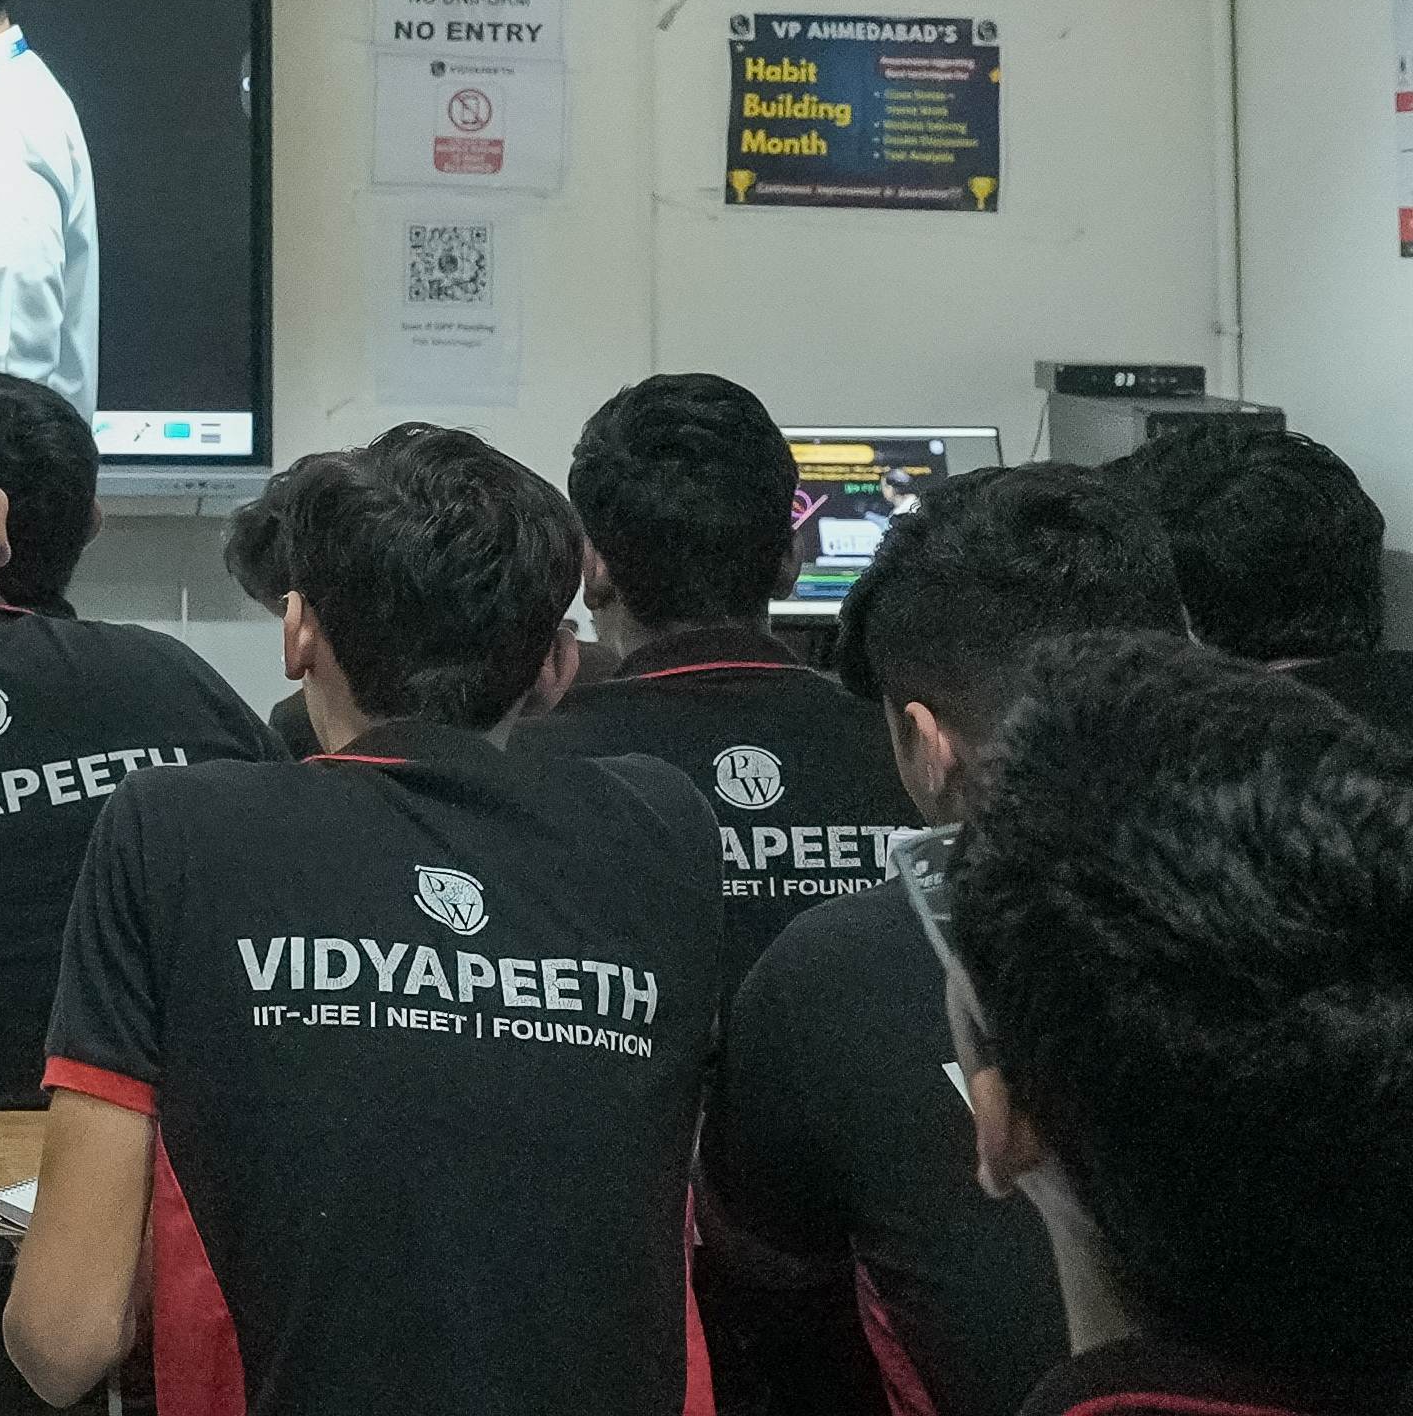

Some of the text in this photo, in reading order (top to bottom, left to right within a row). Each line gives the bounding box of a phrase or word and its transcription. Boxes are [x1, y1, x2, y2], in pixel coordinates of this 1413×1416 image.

[394, 20, 543, 43] NO ENTRY
[771, 21, 802, 40] VP
[744, 57, 818, 84] Habit
[742, 92, 853, 127] Building
[740, 129, 829, 157] Month
[719, 825, 931, 870] APEET
[237, 935, 658, 1025] VIDYAPEETH
[253, 1004, 361, 1027] IIT-JEE
[387, 1009, 468, 1034] NEET
[493, 1017, 652, 1058] FOUNDATION
